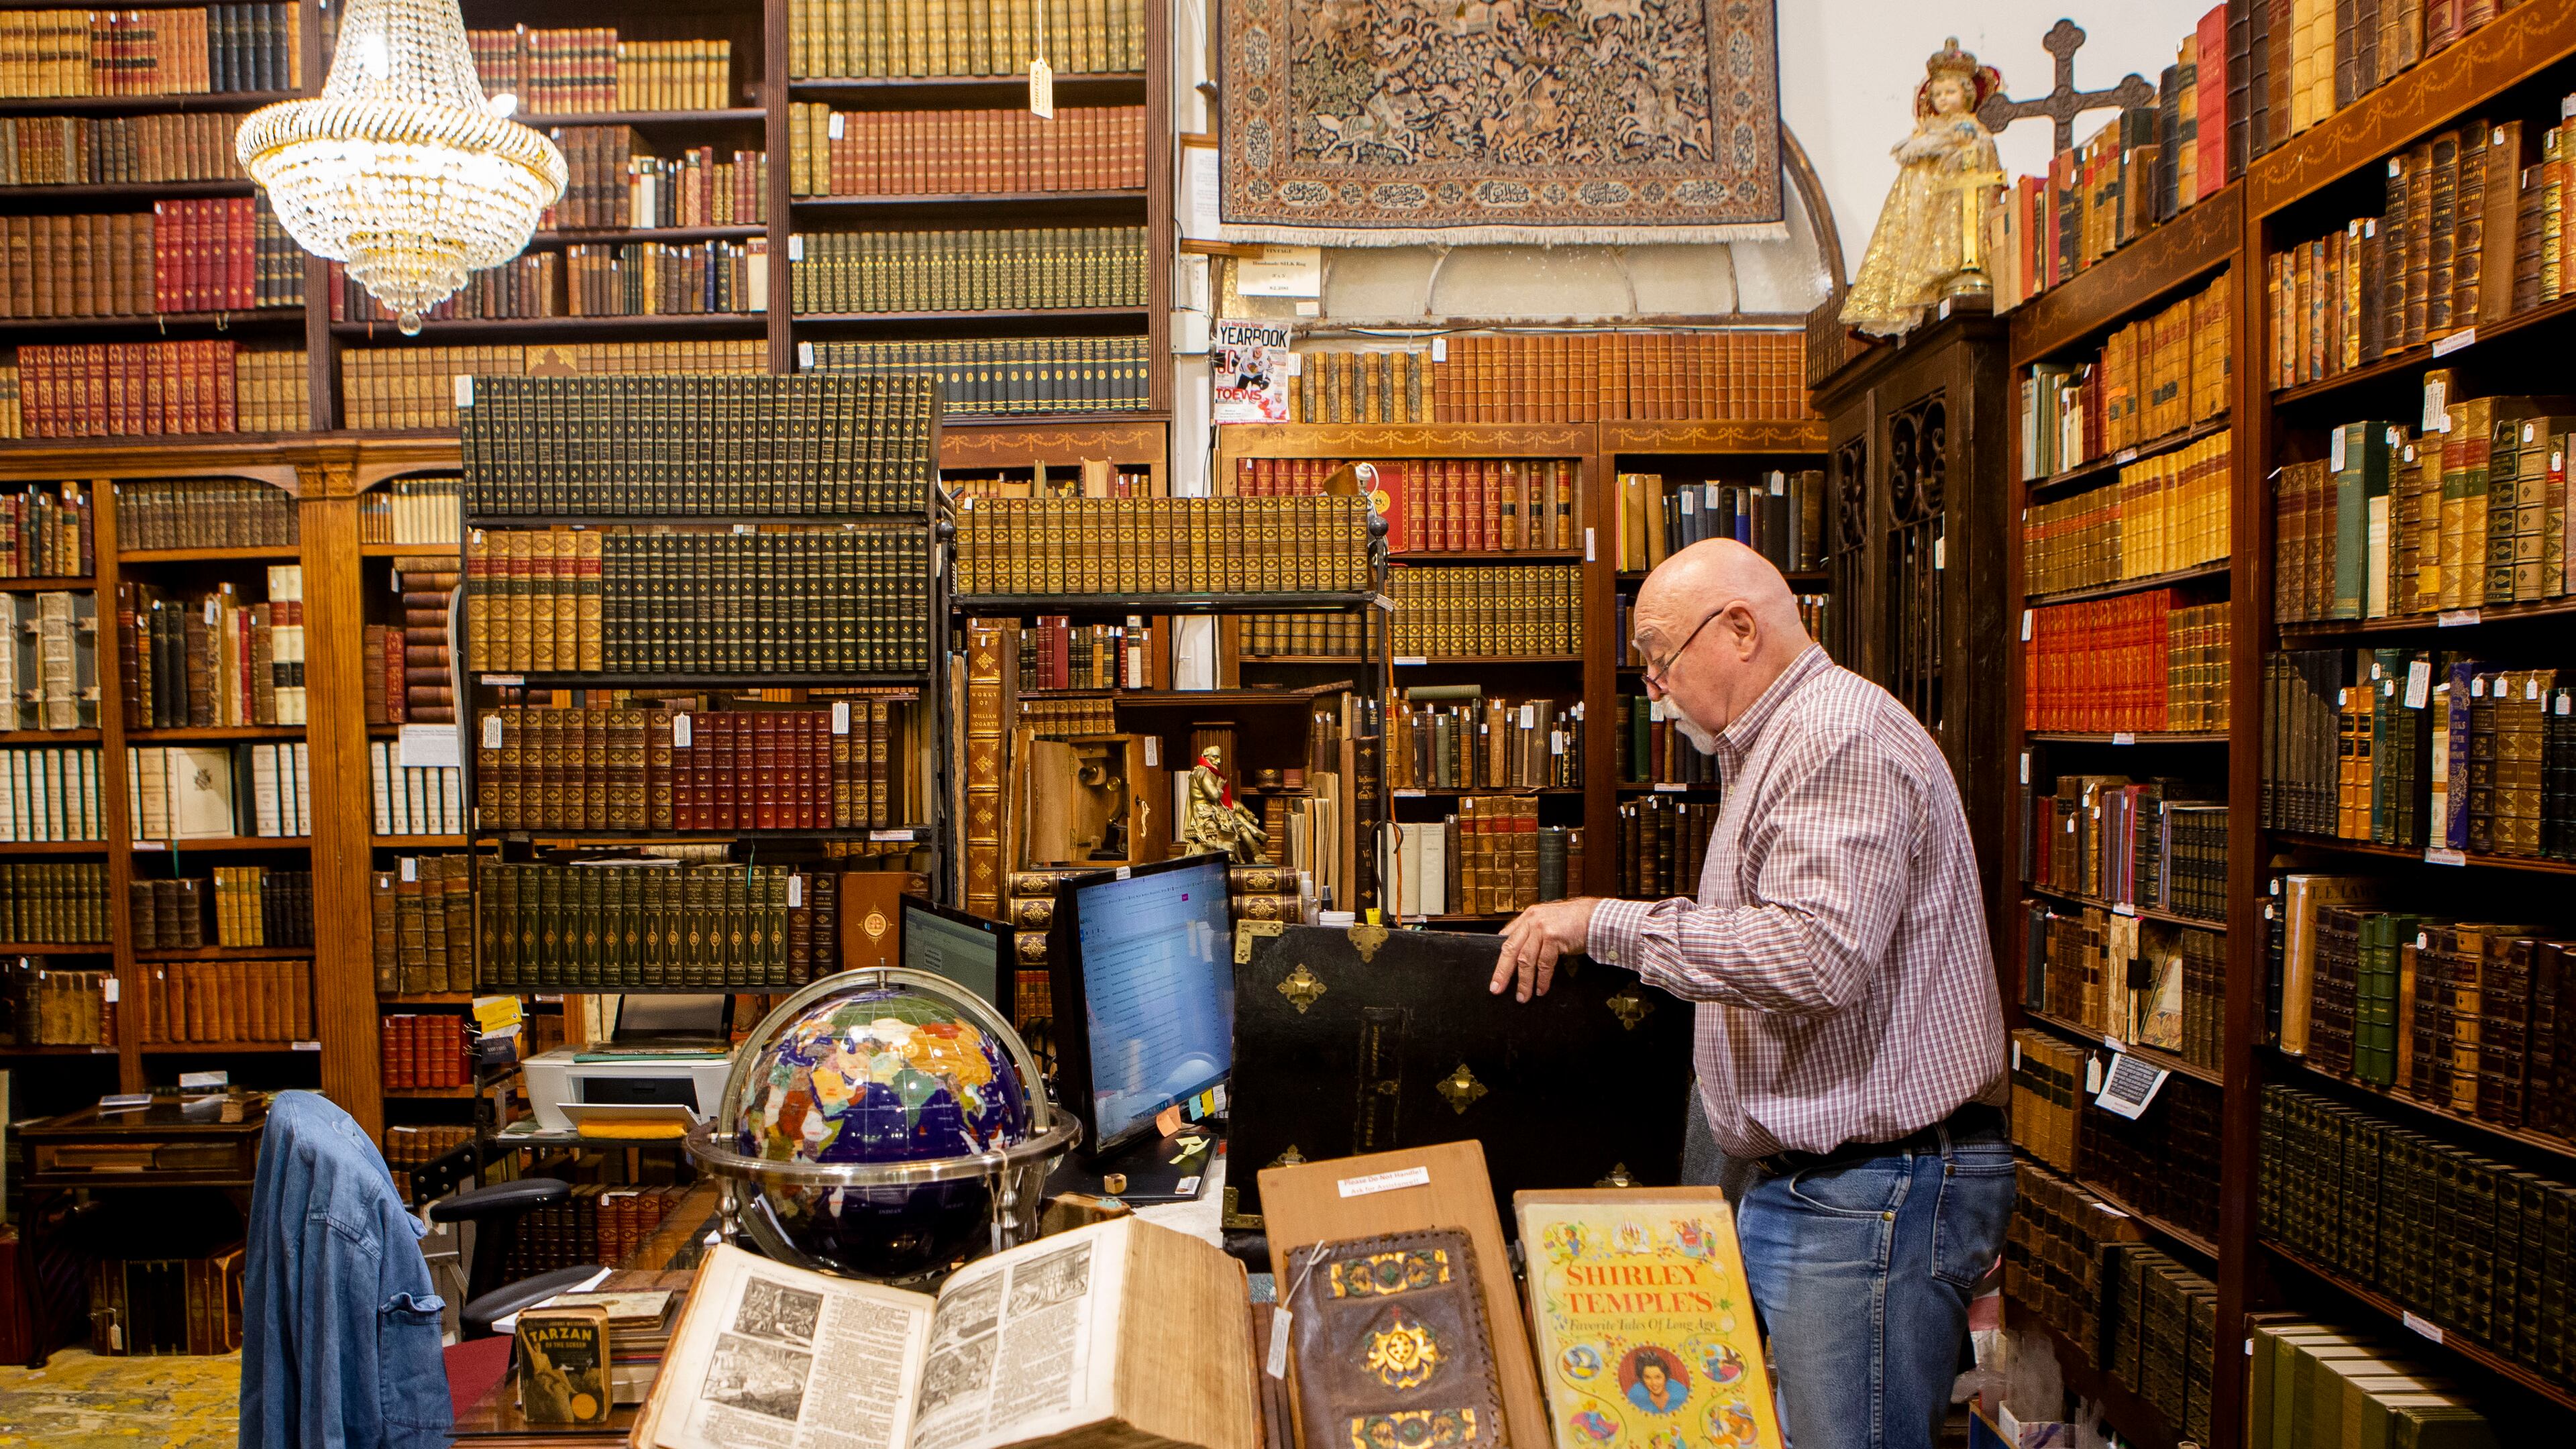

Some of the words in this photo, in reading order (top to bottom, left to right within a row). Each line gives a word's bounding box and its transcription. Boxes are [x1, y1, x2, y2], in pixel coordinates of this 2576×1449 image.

[1220, 327, 1288, 347] YEARBOOK
[1216, 388, 1262, 401] TOEWS
[1566, 1265, 1699, 1287] SHIRLEY
[1563, 1291, 1713, 1313] TEMPLE'S
[1569, 1318, 1615, 1331] Favorite
[1617, 1318, 1645, 1331] Tales
[1648, 1318, 1663, 1333] Of
[1666, 1318, 1693, 1333] Long
[529, 1327, 592, 1342] TARZAN
